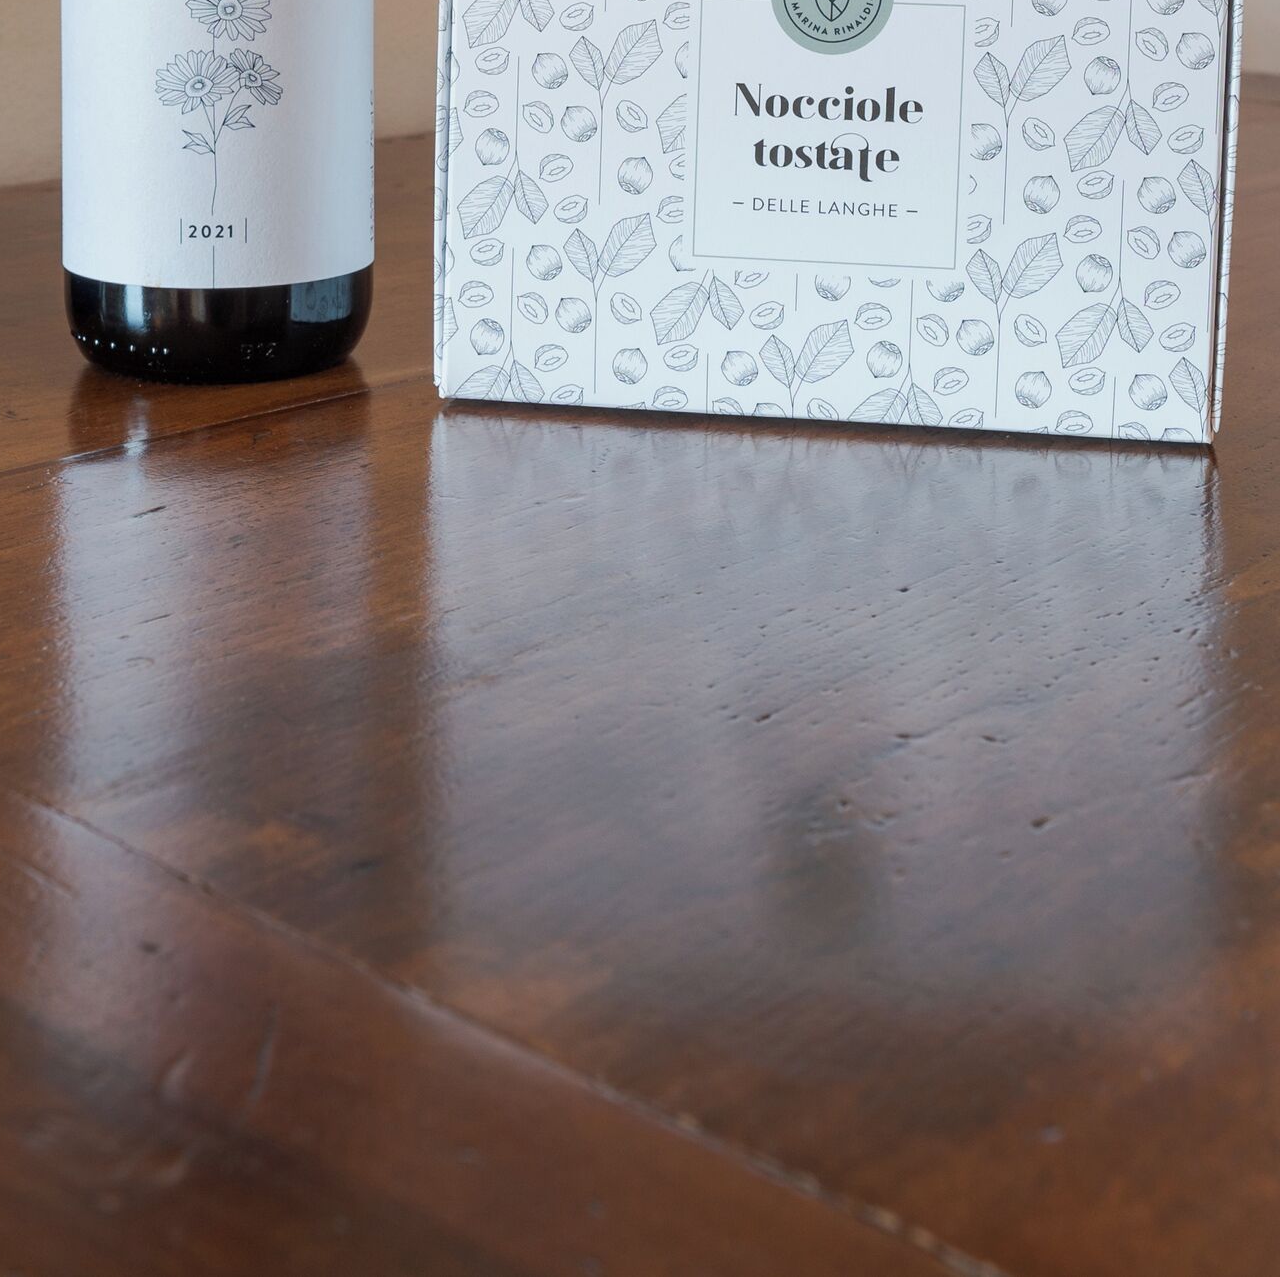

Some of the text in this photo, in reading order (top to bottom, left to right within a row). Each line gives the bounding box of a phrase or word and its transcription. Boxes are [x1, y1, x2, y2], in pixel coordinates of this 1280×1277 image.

[791, 2, 874, 35] MARINA RINALDI
[734, 82, 924, 124] Nocciole
[753, 132, 900, 182] tostate
[752, 197, 898, 218] DELLE LANGHE
[188, 225, 235, 239] 2021
